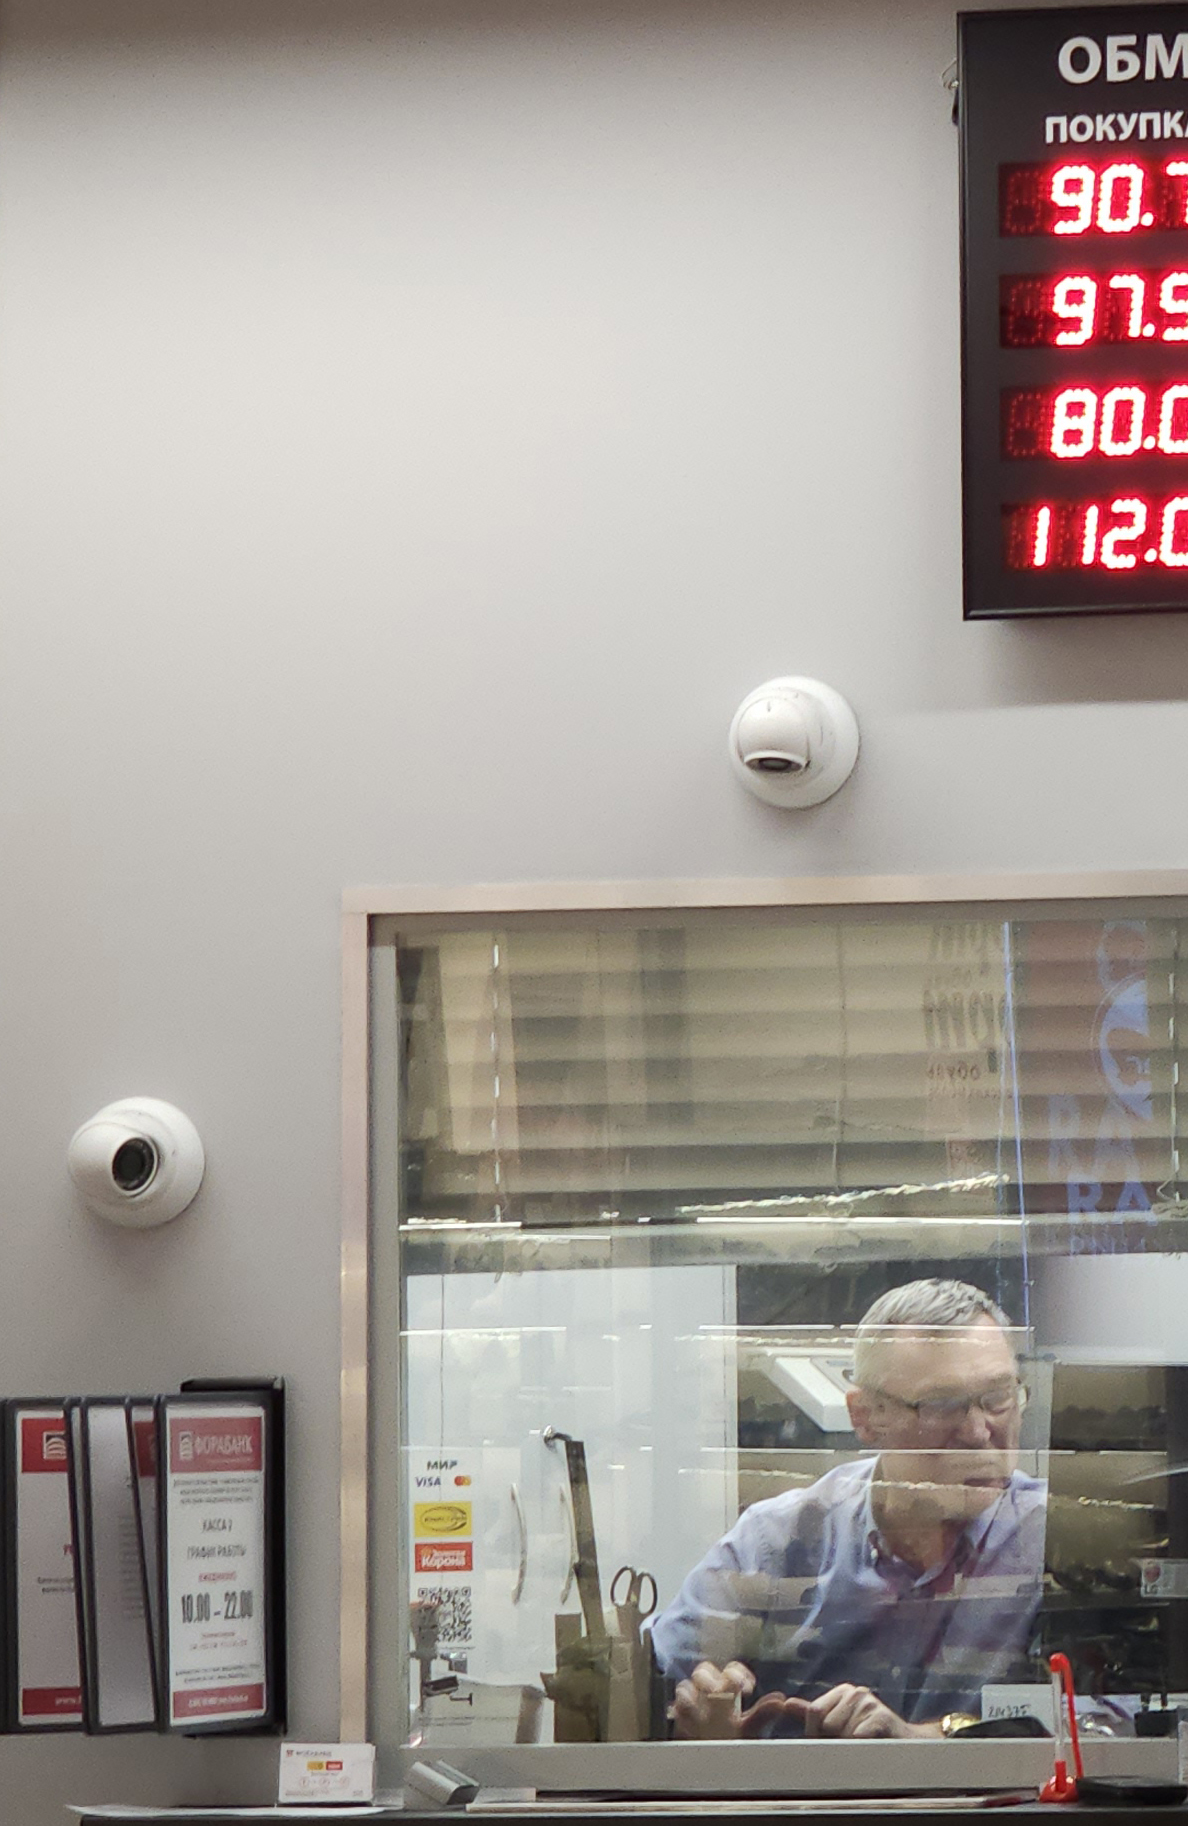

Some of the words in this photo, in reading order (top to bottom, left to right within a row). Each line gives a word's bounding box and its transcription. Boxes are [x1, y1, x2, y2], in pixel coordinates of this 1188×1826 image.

[426, 1461, 458, 1471] МИР
[415, 1476, 442, 1488] VISA
[181, 1592, 211, 1624] 10.00
[223, 1590, 254, 1621] 22.00
